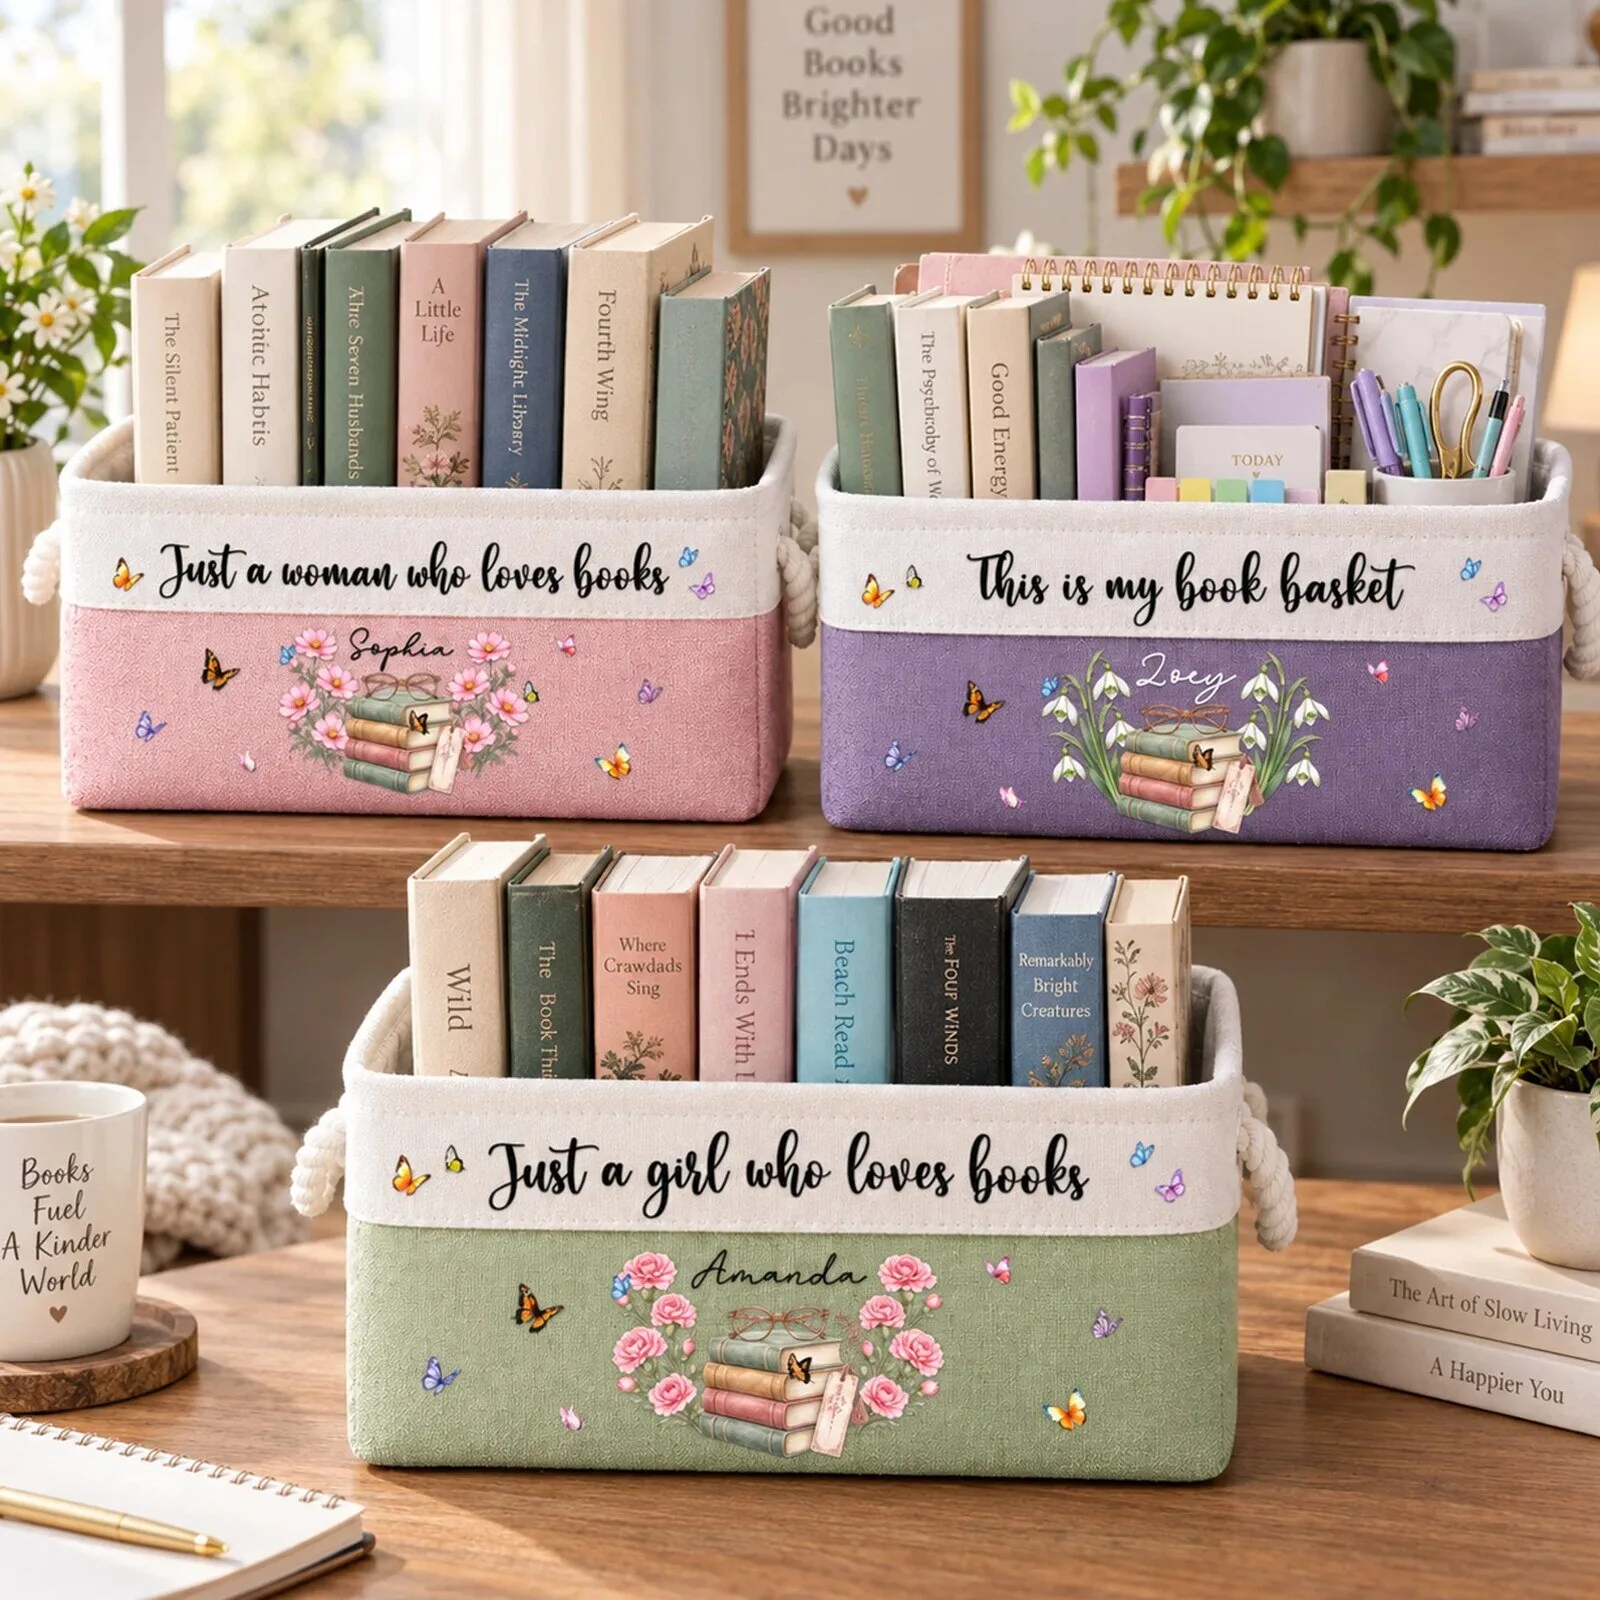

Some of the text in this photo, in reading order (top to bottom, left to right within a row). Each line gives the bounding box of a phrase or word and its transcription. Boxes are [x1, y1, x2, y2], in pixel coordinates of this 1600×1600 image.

[804, 4, 895, 36] Good
[803, 46, 903, 78] Books
[782, 88, 921, 128] Brighter
[812, 133, 893, 170] Days
[431, 277, 445, 295] A
[513, 278, 530, 311] The
[414, 299, 462, 318] Little
[422, 324, 455, 348] Life
[920, 331, 935, 364] The
[590, 290, 617, 423] Fourth Wing
[164, 312, 182, 473] The Silent Patient
[989, 362, 1011, 498] Good Energy
[926, 457, 942, 475] of
[1231, 454, 1284, 467] TODAY
[158, 540, 670, 599] Just a woman who loves books
[966, 549, 1416, 627] This is my book basket
[349, 627, 455, 673] Sophia
[538, 940, 556, 979] The
[619, 936, 667, 953] Where
[1019, 952, 1094, 972] Remarkably
[602, 957, 683, 974] Crawdads
[735, 950, 756, 1005] Ends
[834, 940, 856, 1007] Beach
[446, 963, 473, 1032] Wild
[626, 979, 661, 1000] Sing
[1033, 976, 1078, 998] Bright
[539, 993, 558, 1041] Book
[1020, 1001, 1091, 1021] Creatures
[734, 1010, 756, 1064] With
[834, 1015, 856, 1070] Read
[21, 1153, 94, 1190] Books
[487, 1128, 1090, 1220] Just a girl who loves books
[33, 1189, 87, 1226] Fuel
[1, 1223, 112, 1261] A Kinder
[20, 1258, 96, 1295] World
[690, 1248, 868, 1290] Amanda
[1389, 1277, 1593, 1344] The Art of Slow Living
[1429, 1357, 1565, 1405] A Happier You
